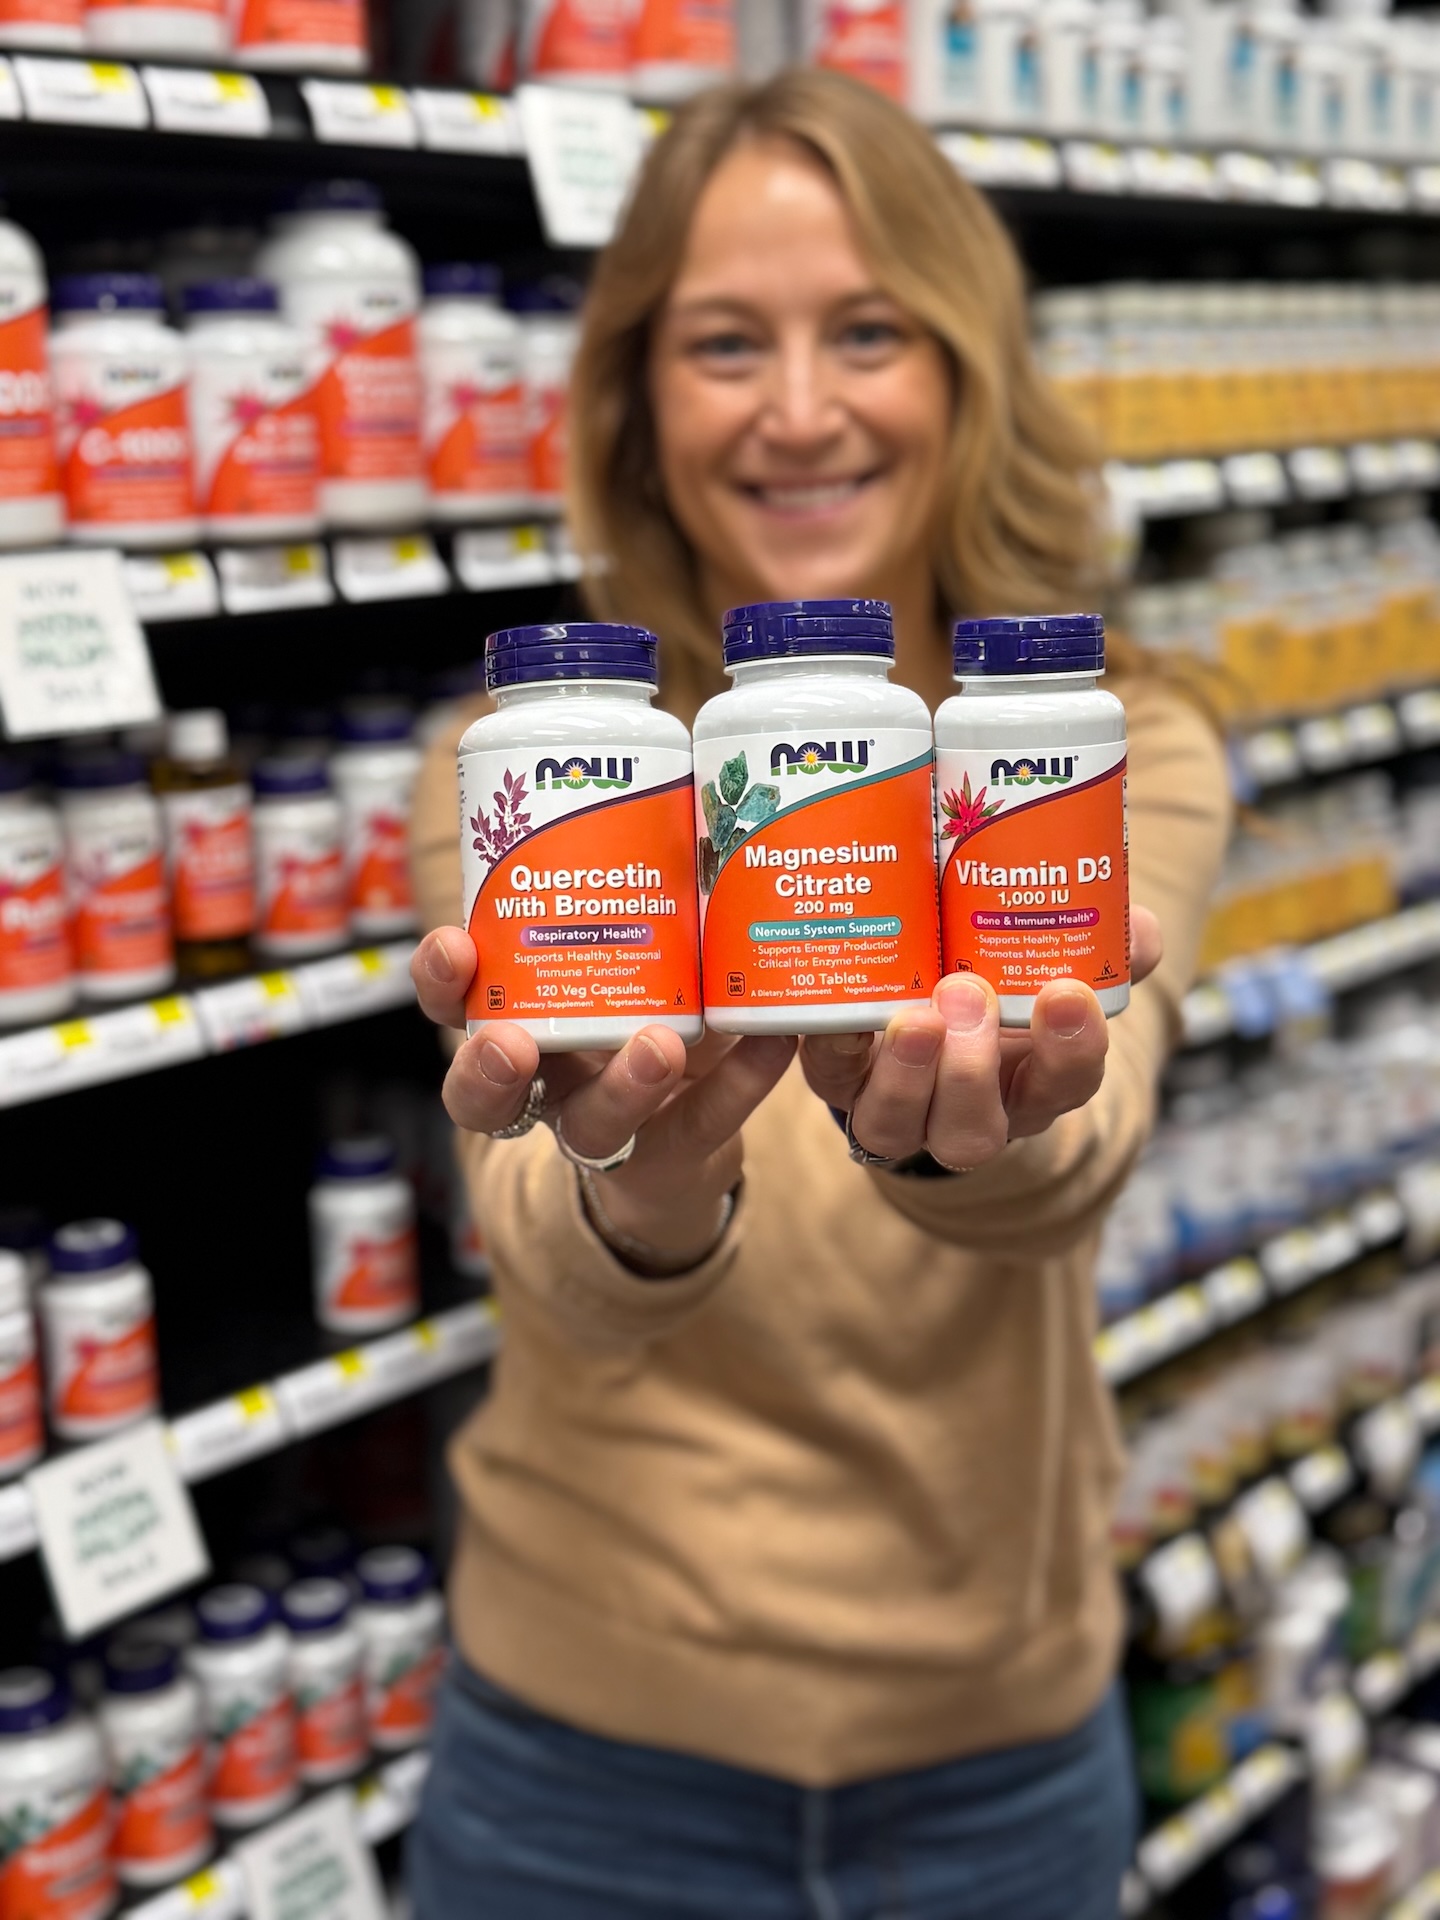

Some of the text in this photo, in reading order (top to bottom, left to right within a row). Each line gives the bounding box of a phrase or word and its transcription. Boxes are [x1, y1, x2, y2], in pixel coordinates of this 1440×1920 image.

[745, 841, 898, 870] Magnesium
[510, 862, 662, 892] Quercetin
[955, 856, 1112, 886] Vitamin D3
[775, 873, 872, 897] Citrate
[998, 889, 1070, 908] 1,000 IU
[495, 894, 677, 918] With Bromelain
[794, 900, 854, 915] 200 mg
[977, 916, 1000, 926] Bone
[1004, 916, 1012, 926] &
[1014, 916, 1056, 926] Immune
[529, 929, 600, 945] Respiratory
[755, 926, 800, 936] Nervous
[804, 924, 846, 938] System
[979, 934, 1020, 946] Supports
[1023, 934, 1060, 945] Healthy
[758, 944, 802, 956] Supports
[804, 942, 841, 954] Energy
[980, 949, 1024, 959] Promotes
[1026, 949, 1060, 958] Muscle
[514, 949, 662, 966] Supports Healthy Seasonal
[758, 959, 792, 969] Critical
[794, 958, 809, 968] for
[812, 957, 852, 968] Enzyme
[536, 968, 582, 978] Immune
[1002, 964, 1072, 977] 180 Softgels
[791, 972, 868, 986] 100 Tablets
[1006, 978, 1032, 988] Dietary
[536, 983, 646, 998] 120 Veg Capsules
[751, 988, 832, 998] A Dietary Supplement
[844, 984, 906, 994] Vegetarian/Vegan
[520, 1001, 546, 1010] Dietary
[548, 1000, 594, 1009] Supplement
[605, 998, 667, 1006] Vegetarian/Vegan
